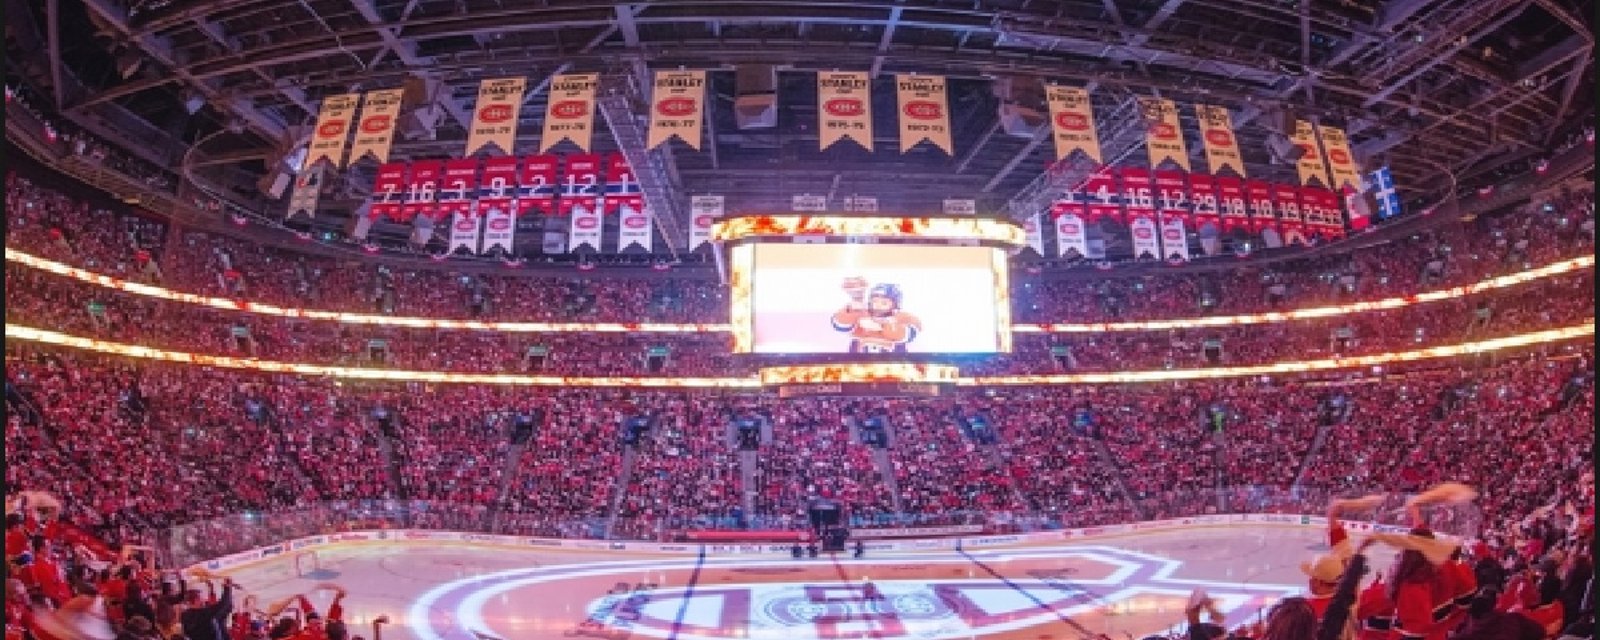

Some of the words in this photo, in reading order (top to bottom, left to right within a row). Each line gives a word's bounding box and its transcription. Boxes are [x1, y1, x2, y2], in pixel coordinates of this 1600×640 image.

[382, 183, 397, 203] 7
[409, 181, 437, 203] 16
[490, 177, 506, 198] 9
[529, 174, 546, 196] 2
[566, 173, 597, 195] 12
